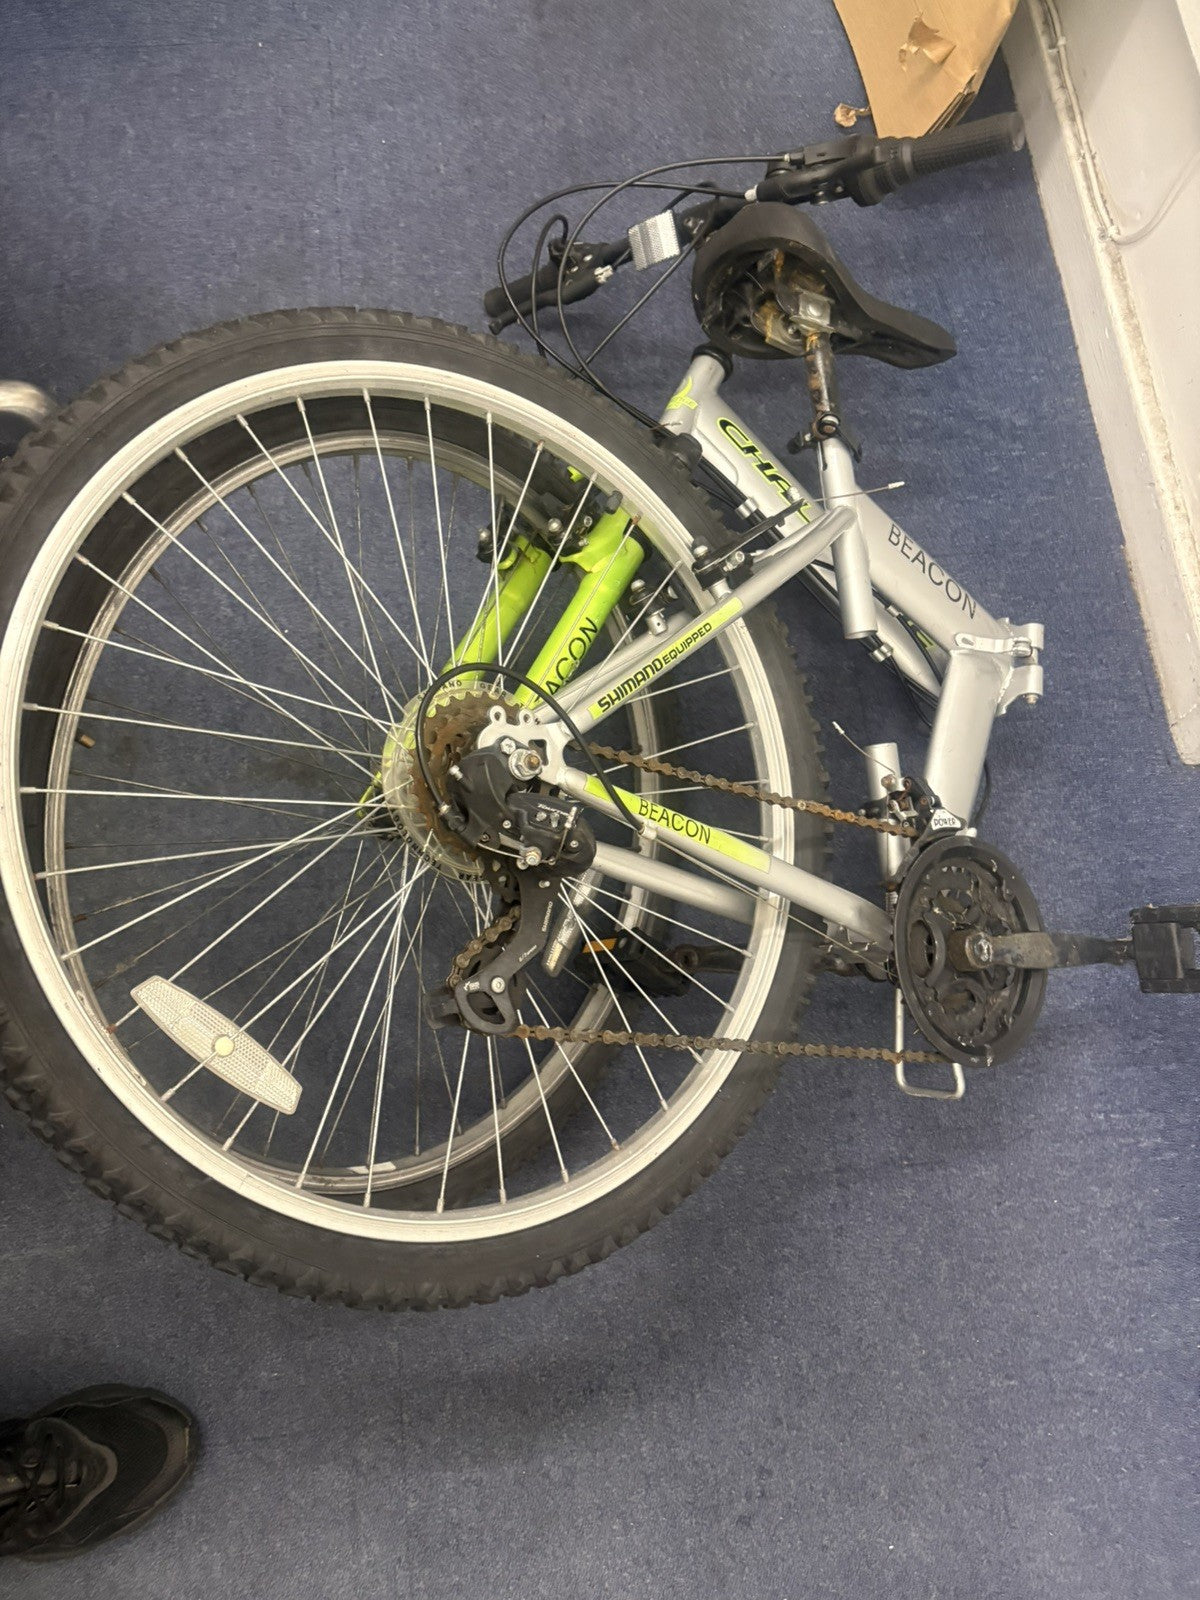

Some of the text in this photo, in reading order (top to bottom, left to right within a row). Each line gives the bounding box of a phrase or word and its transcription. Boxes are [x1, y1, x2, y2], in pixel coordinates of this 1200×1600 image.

[887, 523, 977, 620] BEACON
[527, 616, 598, 704] ACON
[662, 622, 713, 666] EQUIPPED
[638, 798, 712, 845] BEACON
